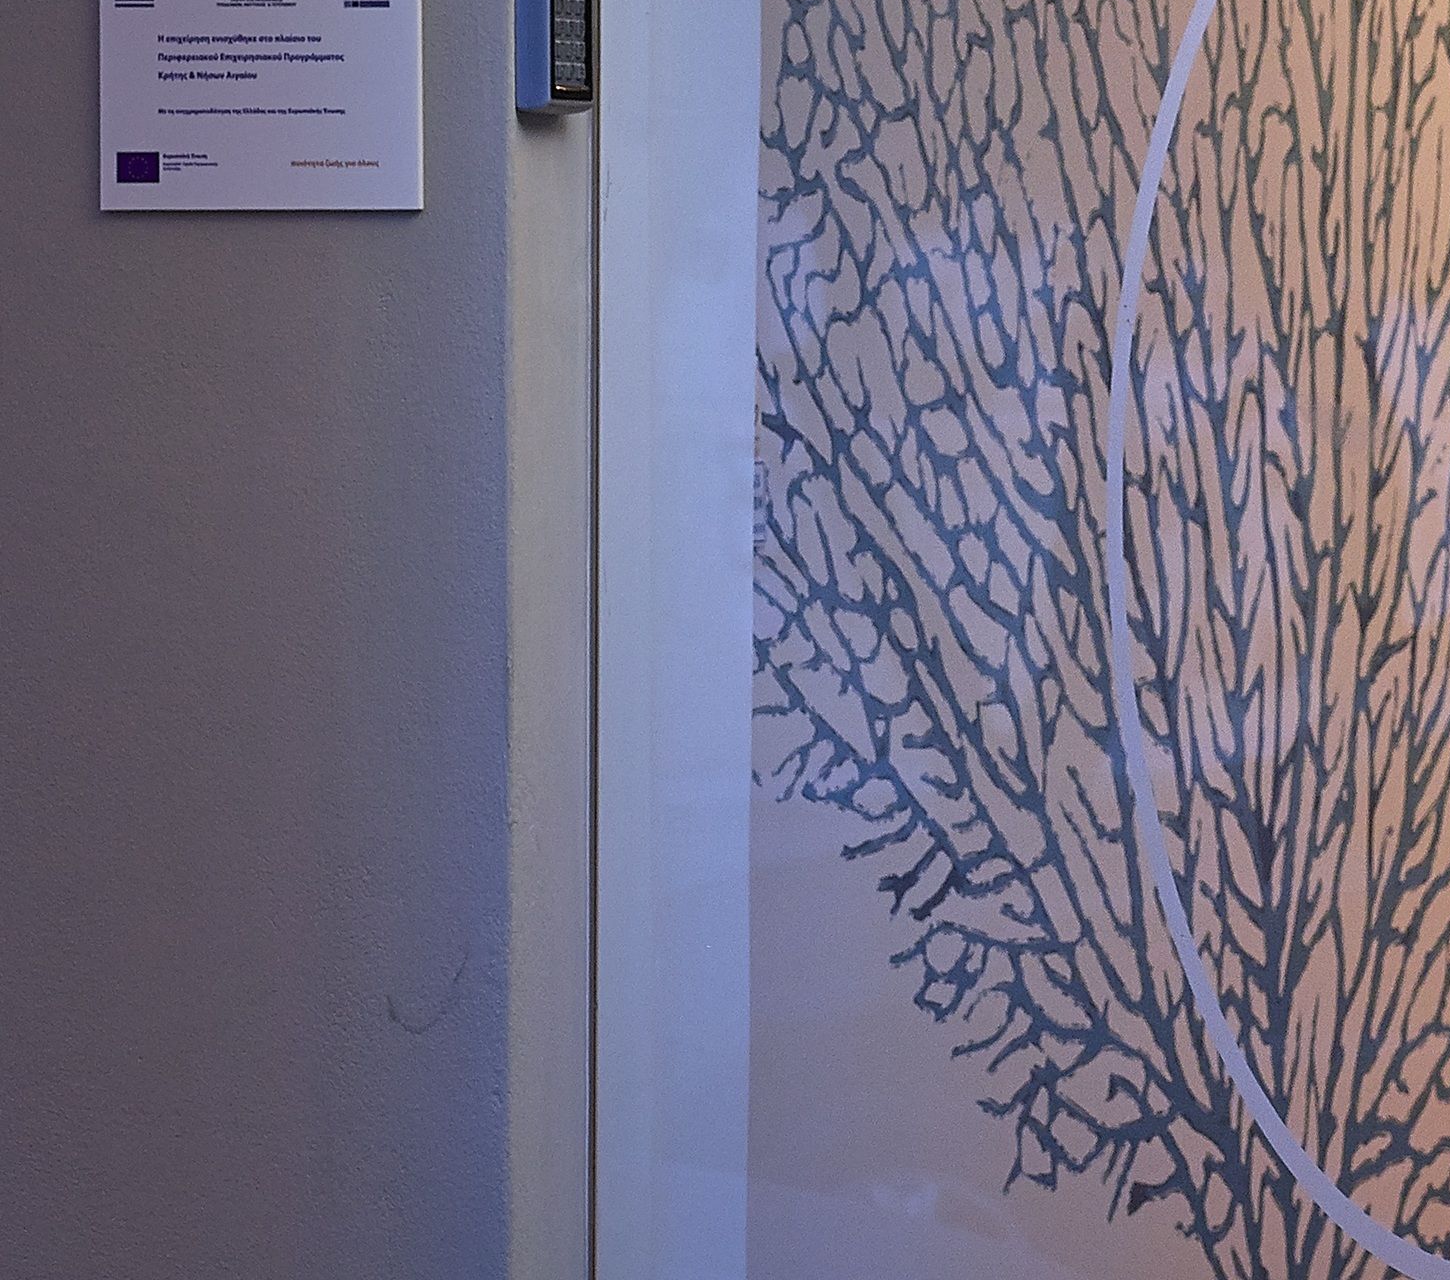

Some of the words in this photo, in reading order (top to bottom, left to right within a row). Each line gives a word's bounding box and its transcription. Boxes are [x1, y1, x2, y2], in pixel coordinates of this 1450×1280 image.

[157, 34, 165, 43] Η
[165, 33, 211, 45] επιχείρηση
[211, 33, 257, 45] ενισχύθηκε
[258, 35, 274, 43] στο
[274, 33, 306, 43] πλαίσιο
[306, 35, 322, 43] του
[157, 52, 219, 63] Περιφερειακού
[220, 52, 282, 63] Επιχειρησιακού
[283, 52, 345, 63] Προγράμματος
[157, 71, 188, 81] Κρήτης
[188, 71, 195, 79] &
[196, 71, 225, 81] Νήσων
[225, 71, 258, 81] Αιγαίου
